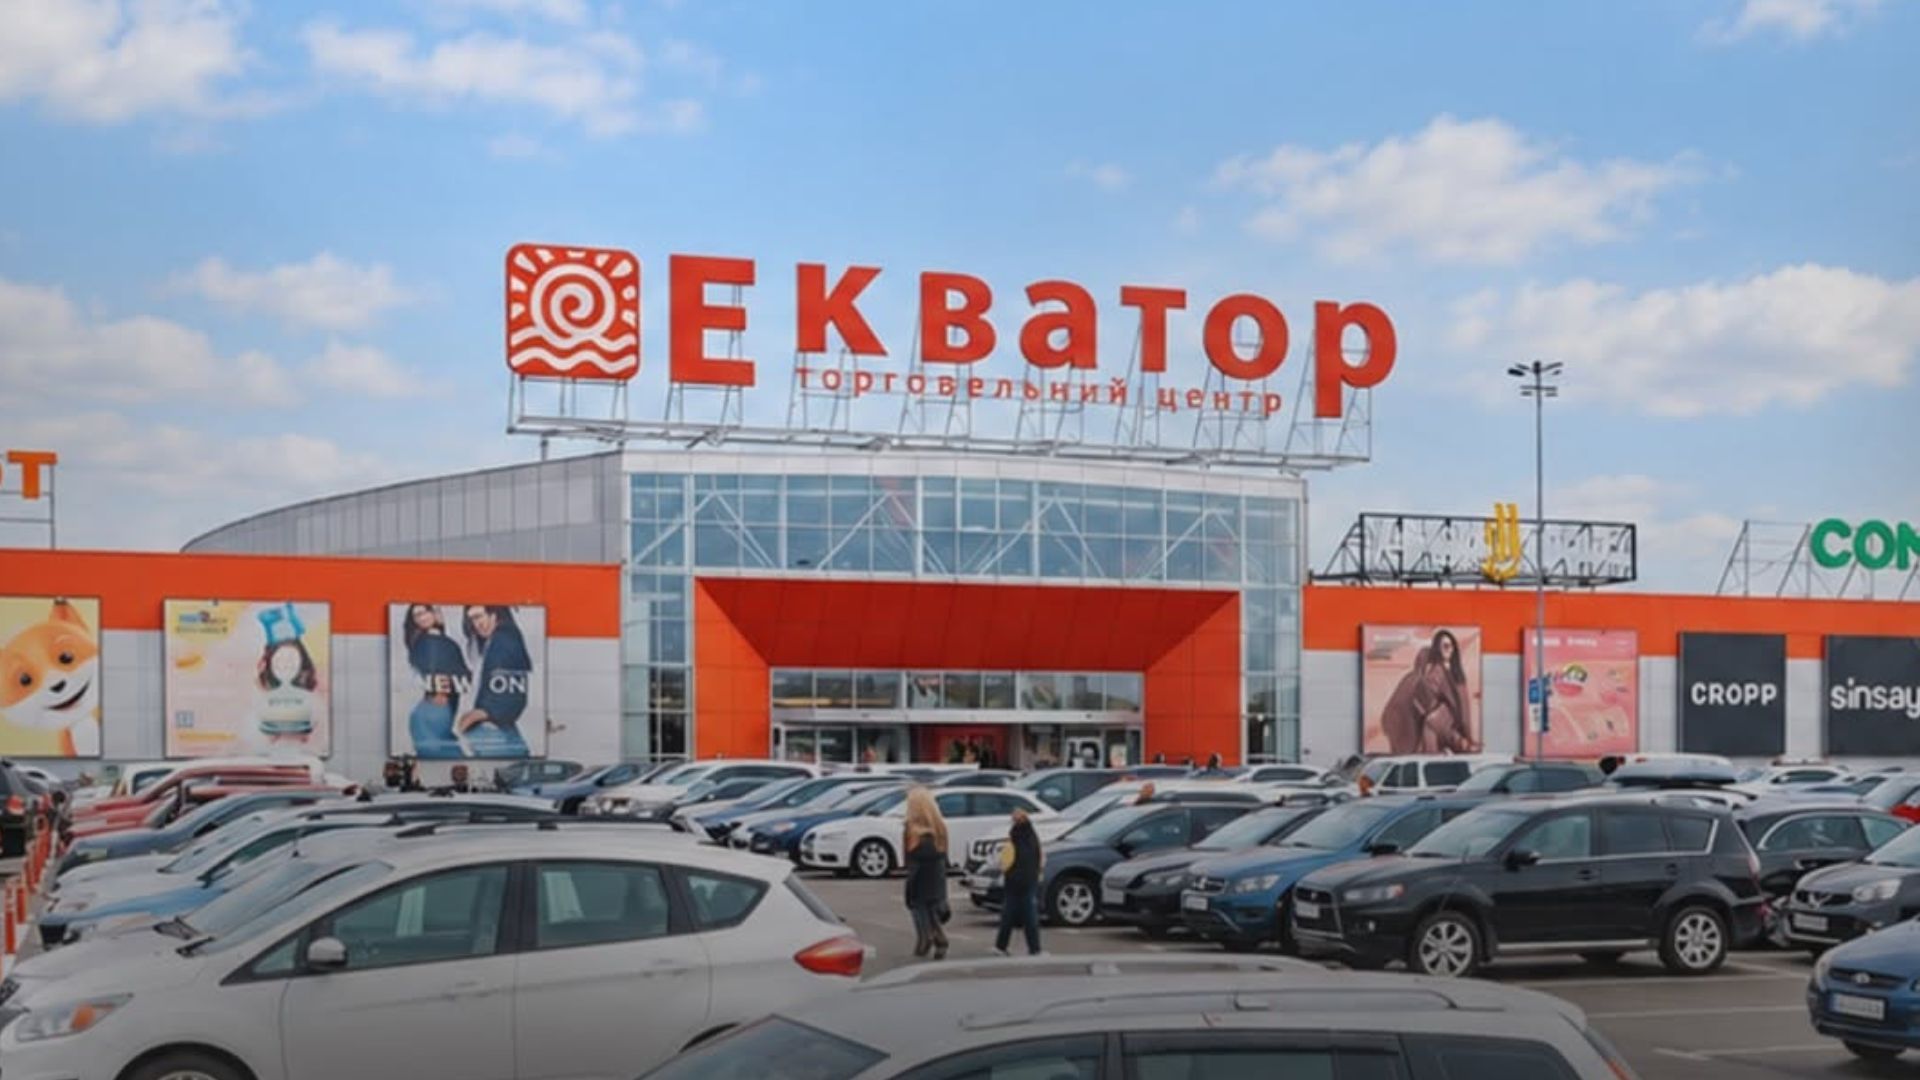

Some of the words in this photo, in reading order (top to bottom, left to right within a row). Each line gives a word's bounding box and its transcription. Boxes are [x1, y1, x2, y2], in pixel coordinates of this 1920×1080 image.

[795, 367, 1127, 407] торговельний
[1157, 388, 1281, 420] центр
[1691, 682, 1777, 705] CROPP
[1830, 677, 1920, 719] sinsay
